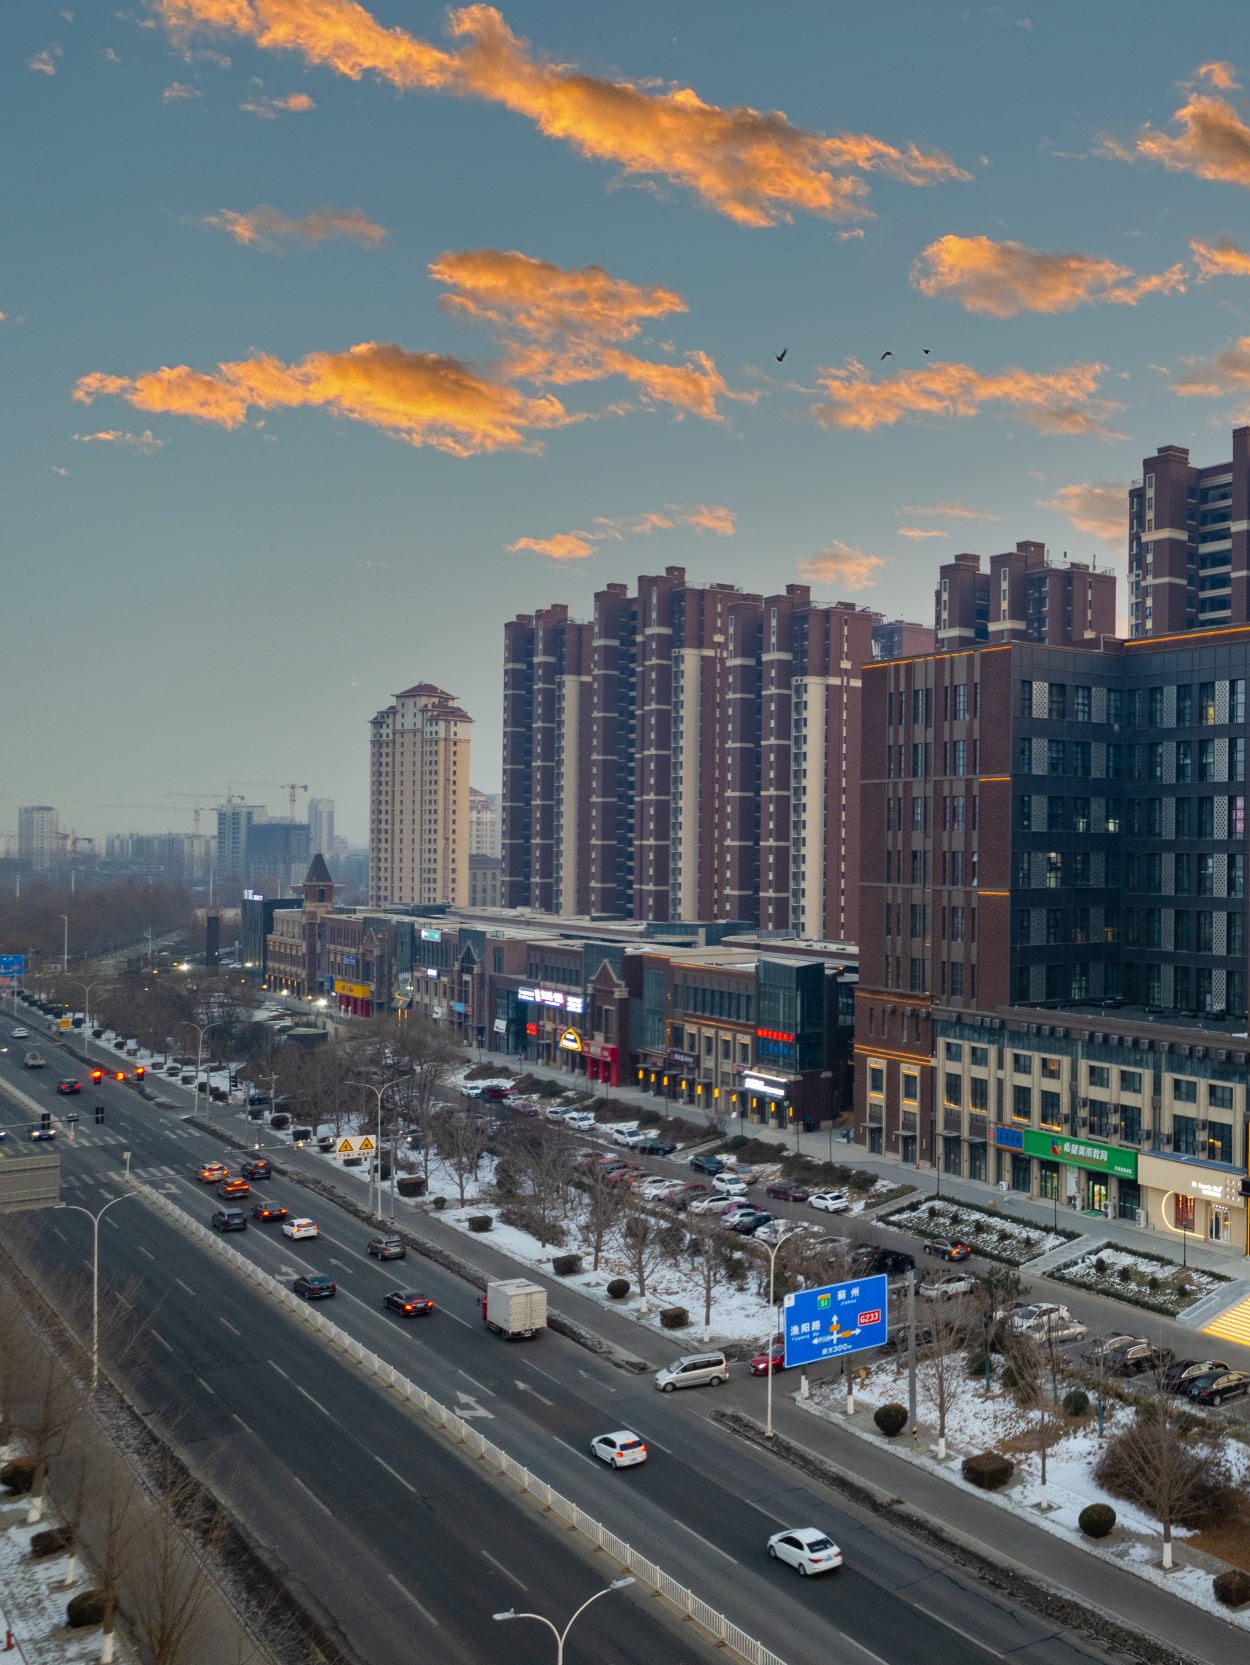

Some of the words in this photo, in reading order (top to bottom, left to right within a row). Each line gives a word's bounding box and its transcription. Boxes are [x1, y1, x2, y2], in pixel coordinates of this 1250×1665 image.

[1063, 1142, 1108, 1161] 希望美术教育
[837, 1286, 860, 1301] 蓟州
[820, 1299, 828, 1307] S1
[860, 1312, 879, 1323] G233
[790, 1320, 821, 1336] 渔阳路
